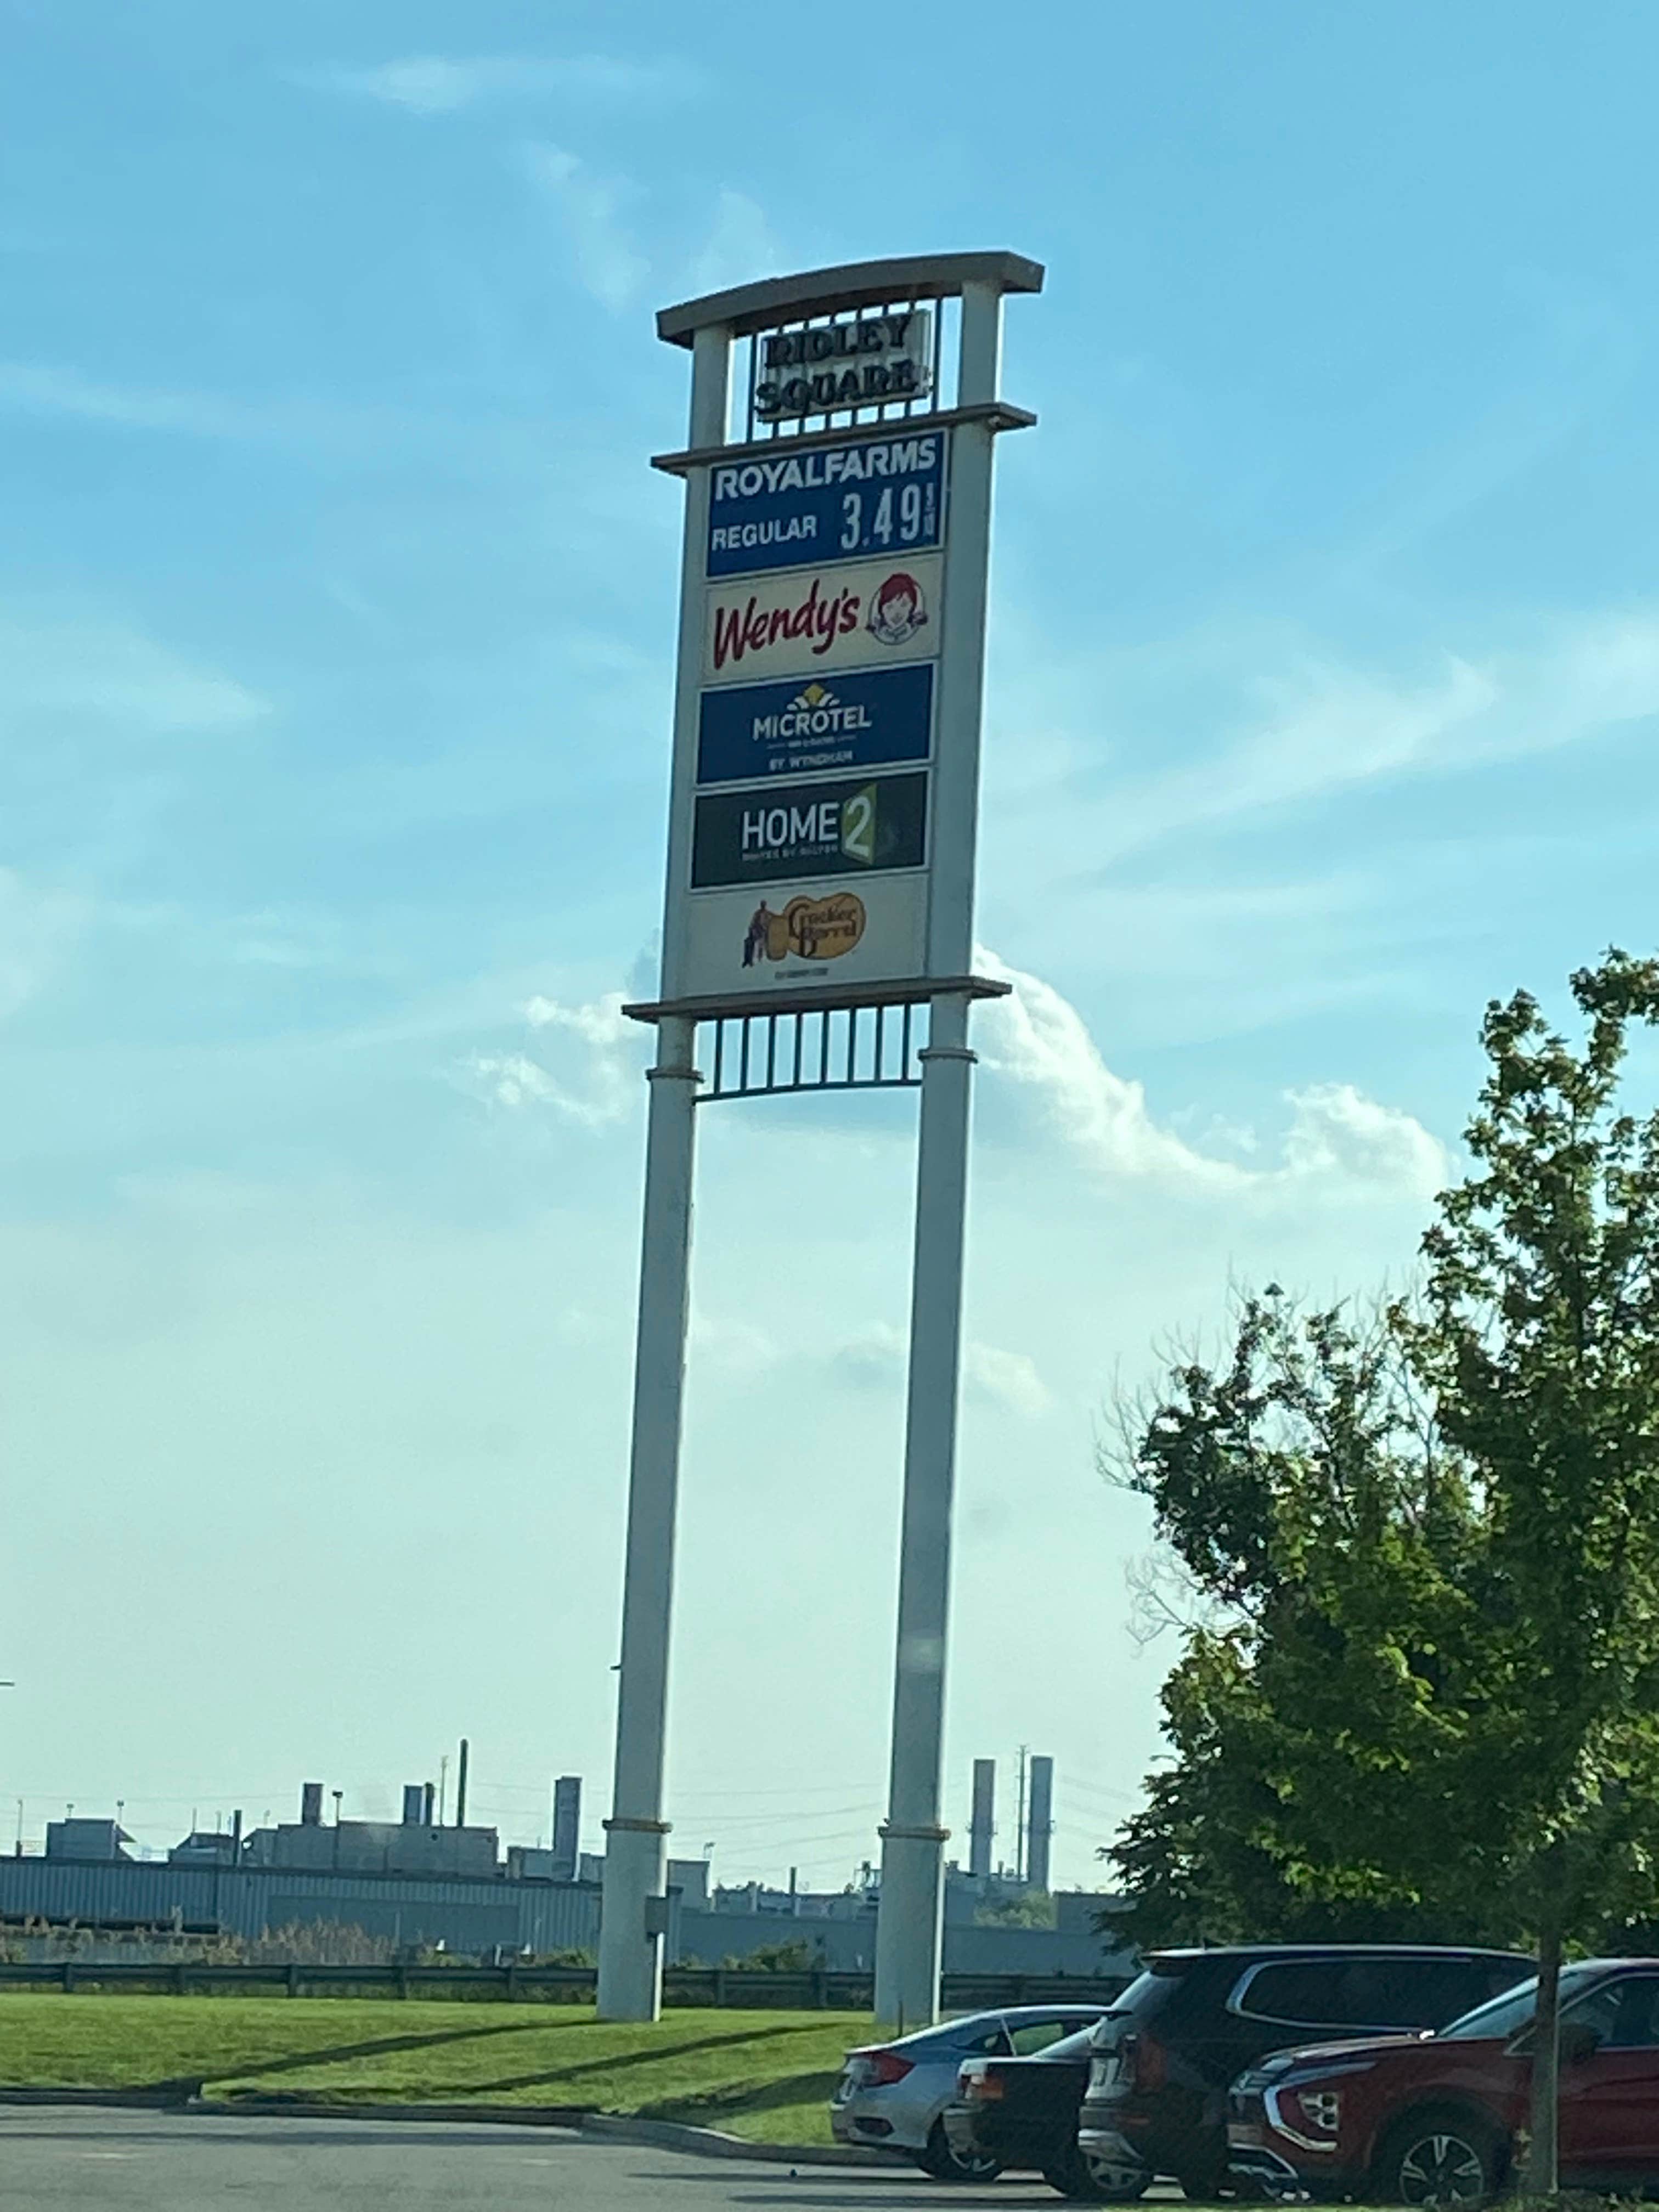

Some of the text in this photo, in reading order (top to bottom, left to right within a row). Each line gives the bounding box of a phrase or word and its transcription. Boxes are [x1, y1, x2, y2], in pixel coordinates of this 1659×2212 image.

[763, 313, 913, 369] RIDLEY
[754, 359, 921, 416] SQUARE
[712, 515, 817, 551] REGULAR
[714, 578, 860, 670] Wendy's
[752, 704, 872, 741] MICROTEL
